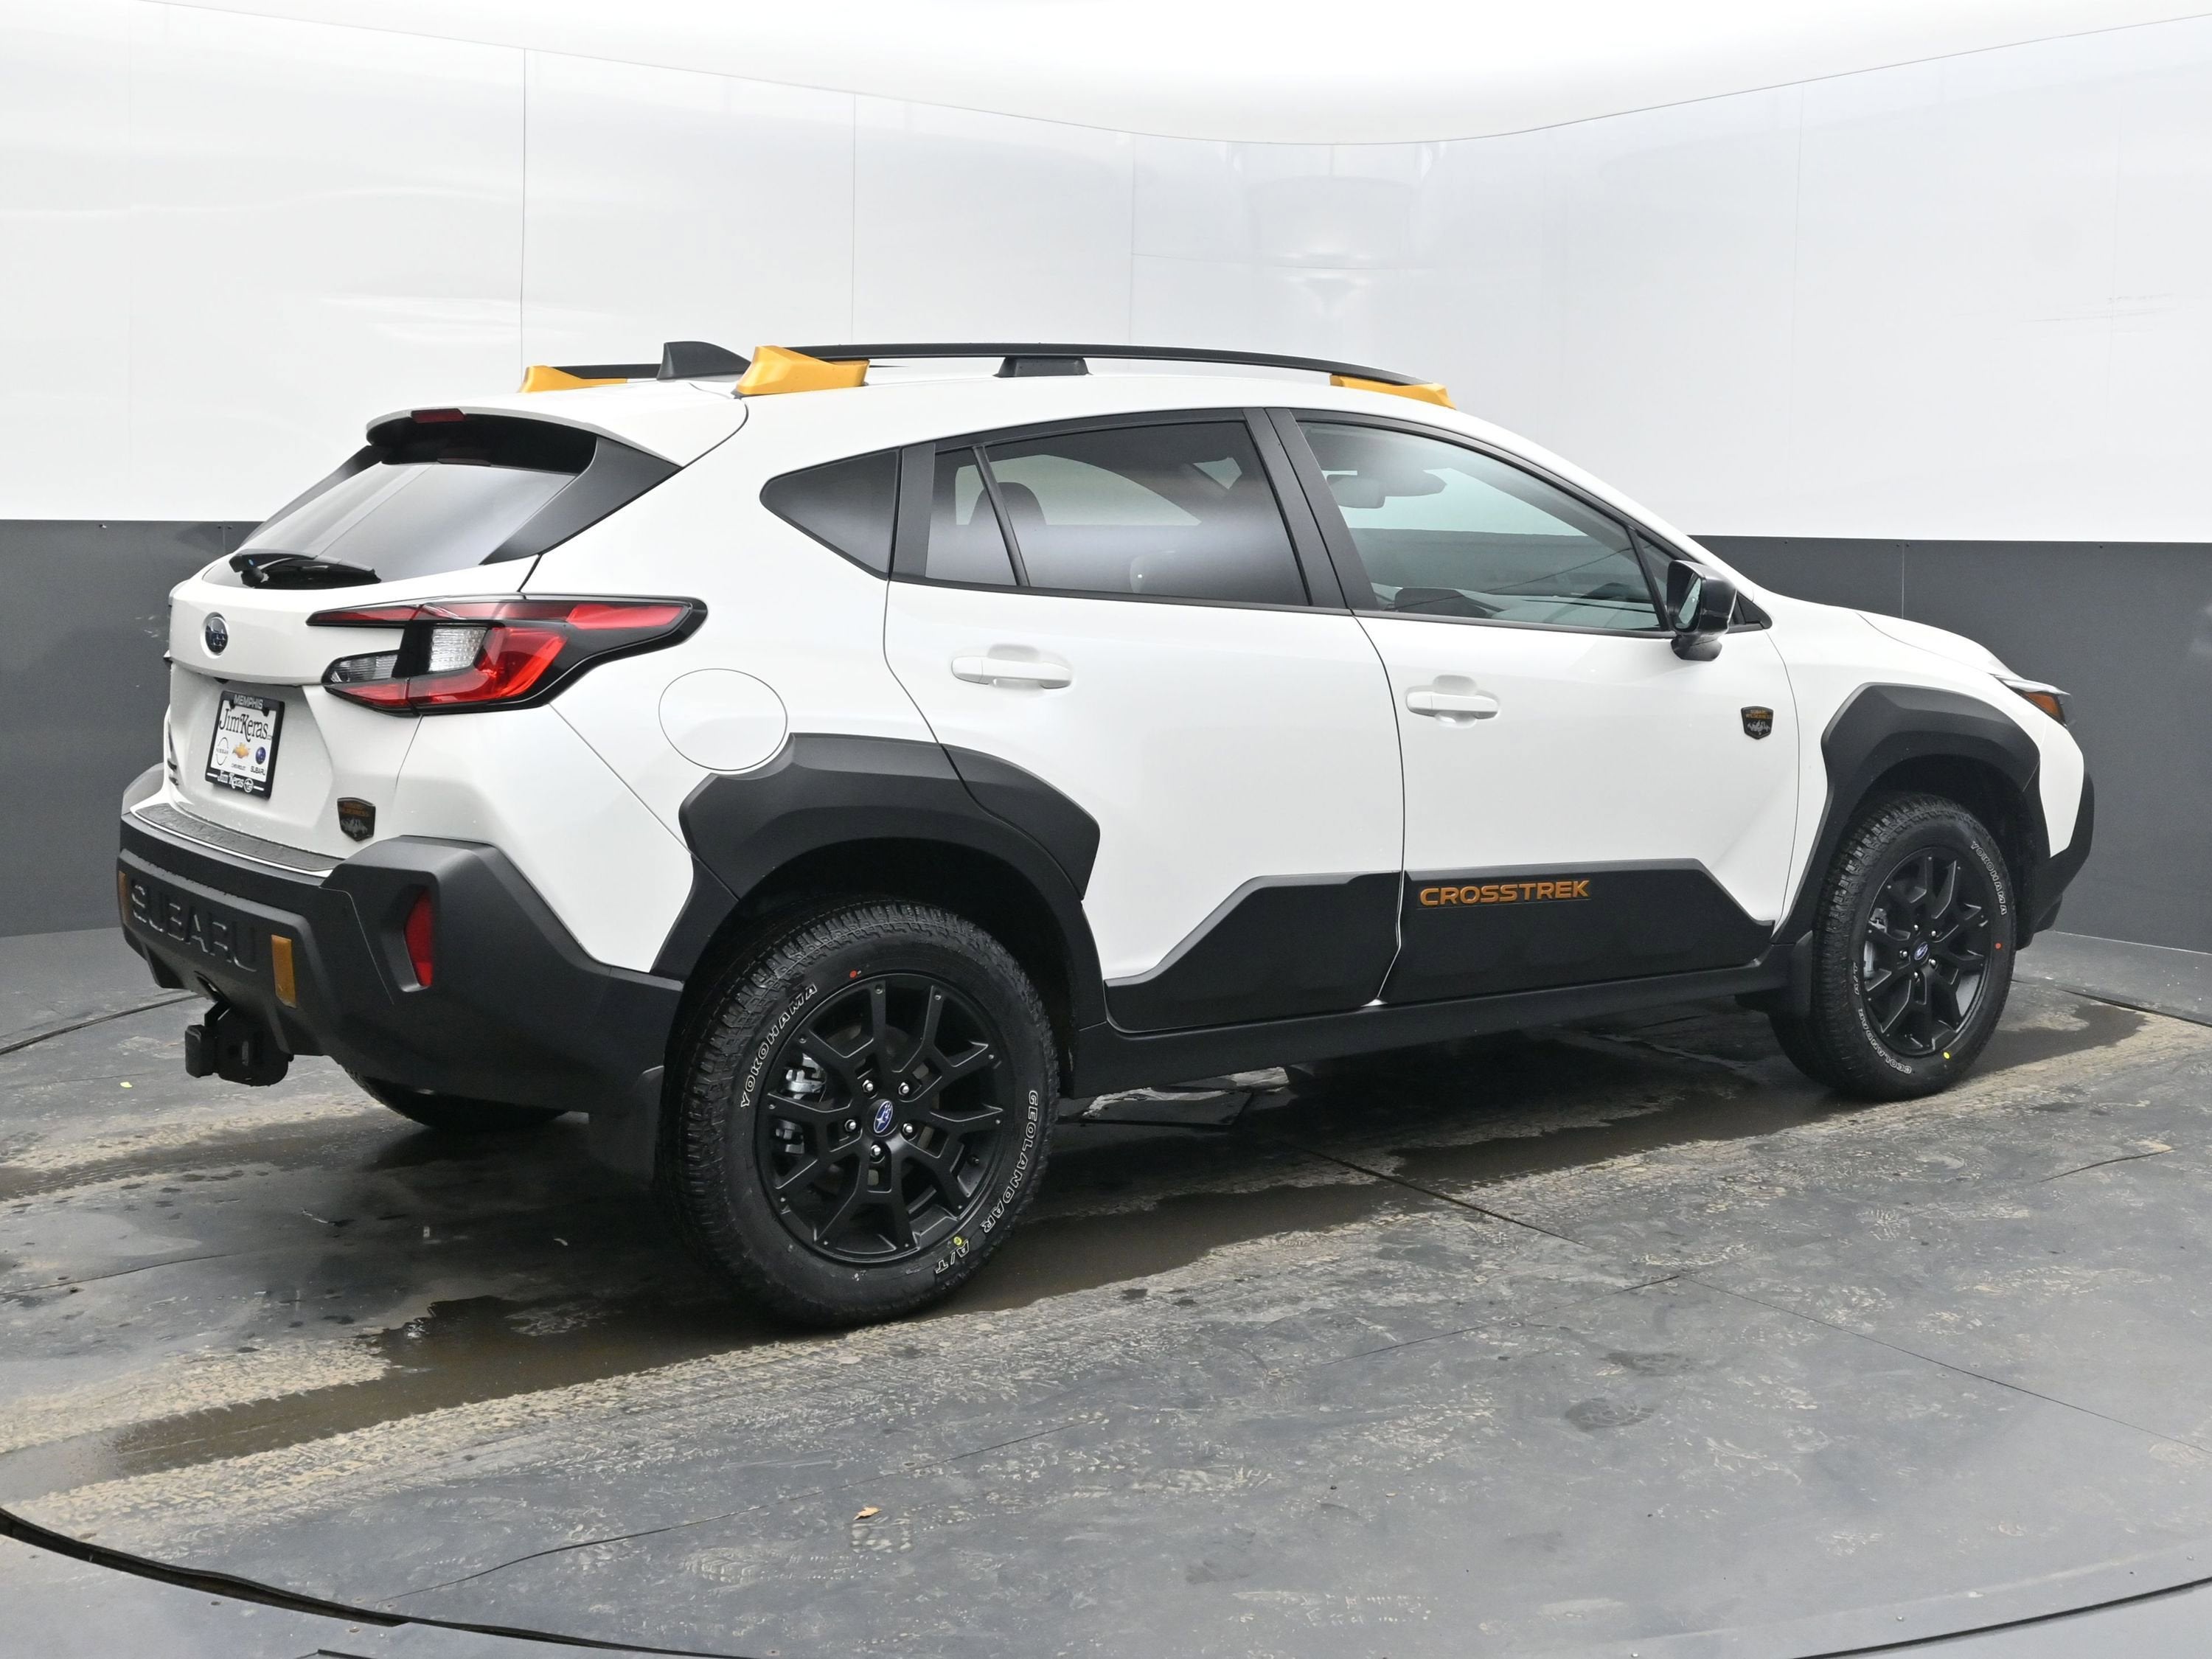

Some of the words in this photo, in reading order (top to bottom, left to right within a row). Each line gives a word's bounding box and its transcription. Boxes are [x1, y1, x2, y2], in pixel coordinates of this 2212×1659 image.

[234, 694, 263, 709] MEMPHIS
[1419, 880, 1590, 905] CROSSTREK
[1971, 841, 2007, 915] YOKOHAMA
[131, 883, 257, 972] SUBARU
[740, 984, 817, 1107] YOKOHAMA
[1858, 1009, 1911, 1074] GEOLANDAR
[980, 1090, 1039, 1233] GEOLANDAR
[934, 1239, 969, 1274] A/T
